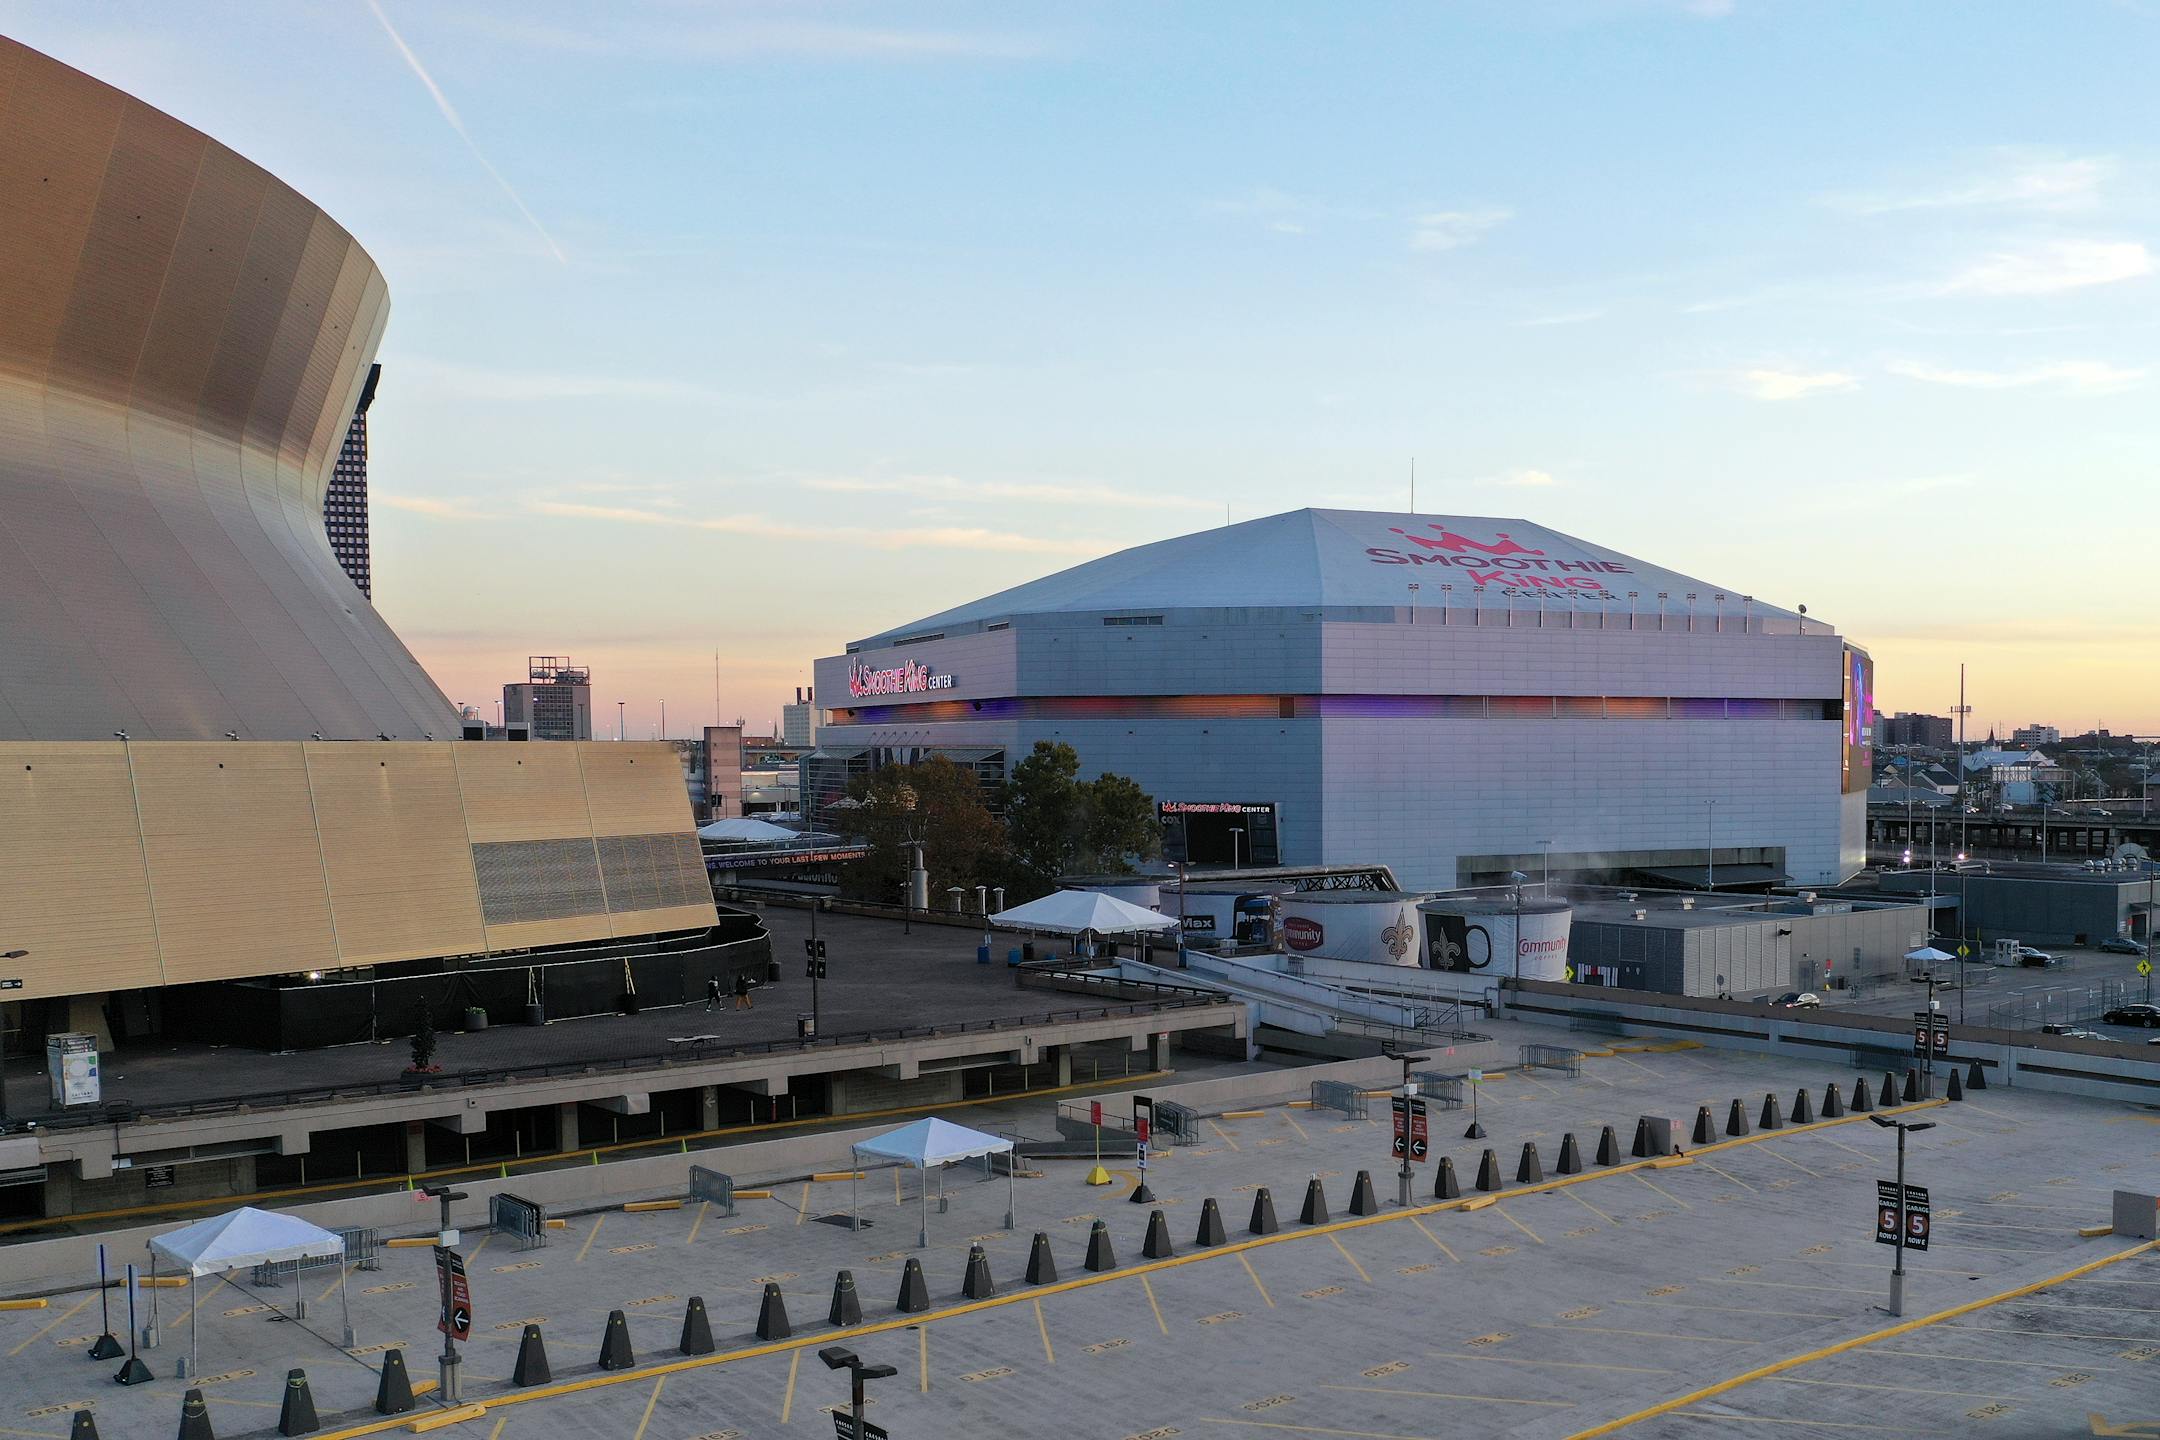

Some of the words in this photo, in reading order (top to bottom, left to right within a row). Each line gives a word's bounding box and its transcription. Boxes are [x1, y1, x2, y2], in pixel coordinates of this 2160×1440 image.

[1365, 548, 1634, 574] SMOOTHIE
[863, 665, 905, 696] SMOOTHIE
[928, 674, 953, 690] CENTER
[719, 859, 755, 869] WELCOME
[757, 858, 768, 866] TO
[770, 856, 791, 865] YOUR
[791, 855, 810, 864] LAST
[813, 854, 829, 862] FEW
[1918, 1031, 1925, 1043] 5
[1936, 1033, 1945, 1045] 5
[1879, 1200, 1898, 1208] GARAG
[1906, 1204, 1929, 1213] GARAGE
[1884, 1211, 1895, 1229] 5
[1912, 1215, 1924, 1234] 5
[1879, 1231, 1892, 1240] ROW
[1908, 1236, 1921, 1245] ROW
[835, 1419, 853, 1430] CAESAR
